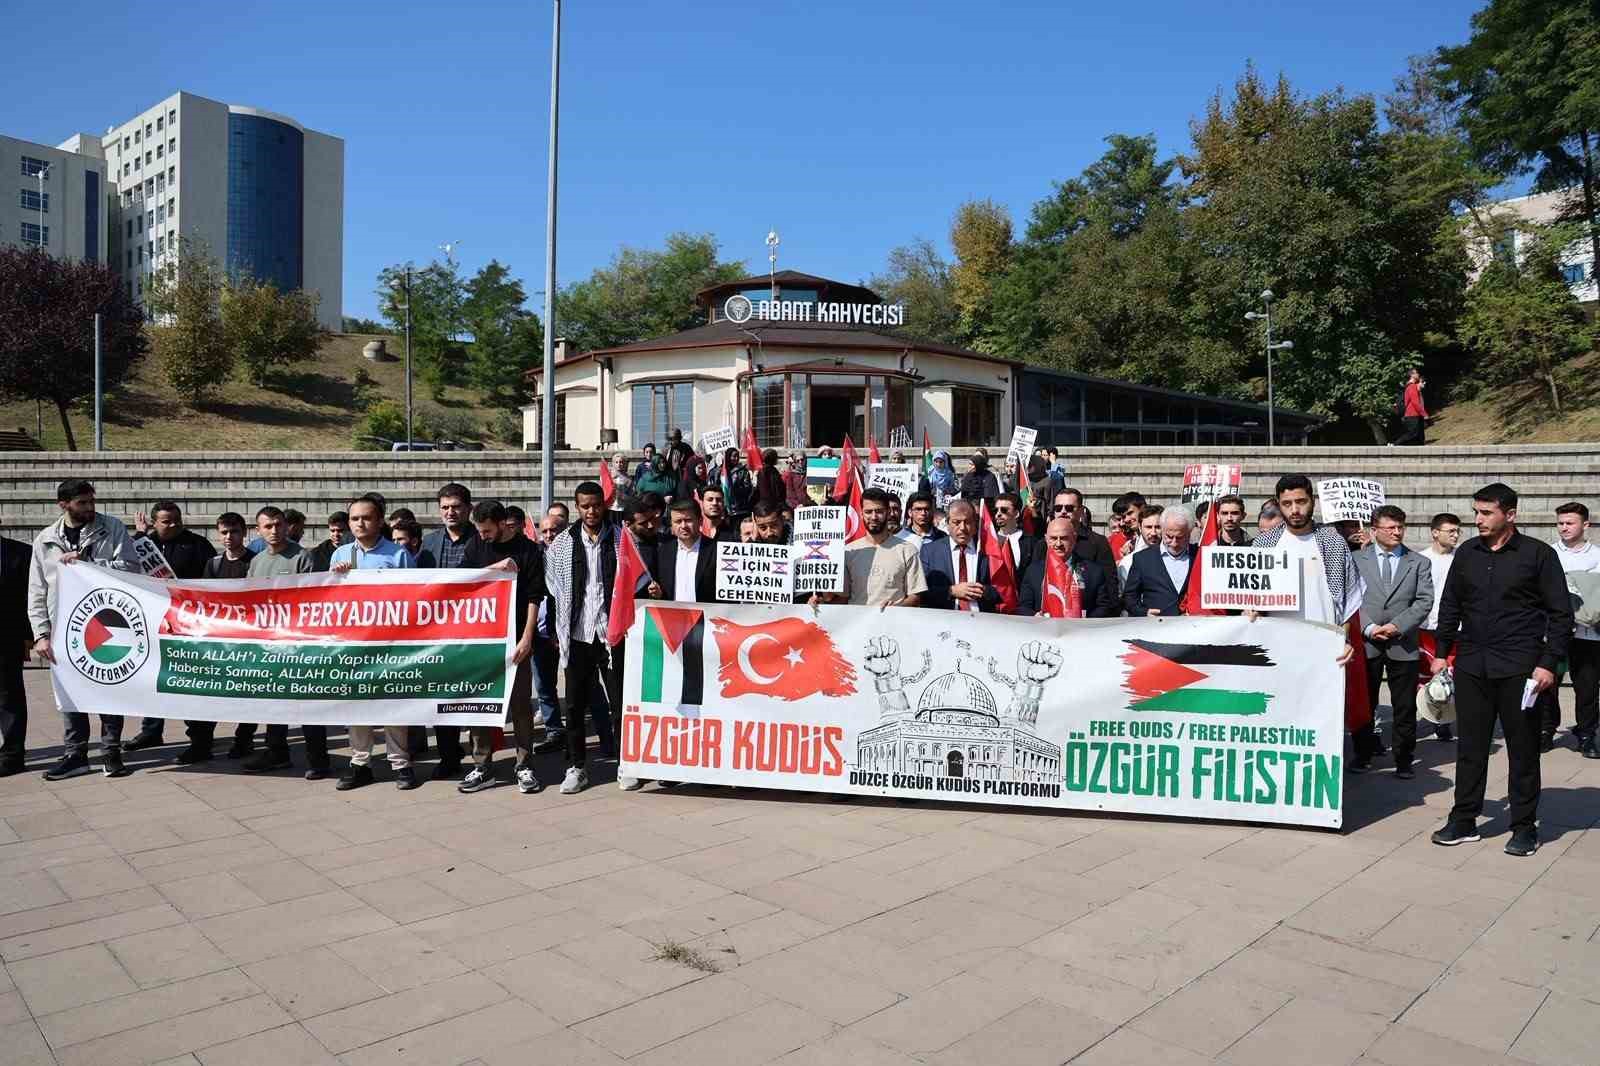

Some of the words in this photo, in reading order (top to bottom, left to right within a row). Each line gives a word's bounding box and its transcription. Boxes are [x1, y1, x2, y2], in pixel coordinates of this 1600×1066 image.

[759, 300, 813, 321] ABANT
[710, 440, 731, 450] VAR!
[798, 508, 840, 520] TERÖRİST
[811, 521, 822, 530] VE
[722, 544, 788, 558] ZALİMLER
[742, 559, 771, 573] İÇİN
[795, 562, 839, 576] SÜRESİZ
[727, 575, 783, 588] YAŞASIN
[795, 578, 837, 590] BOYKOT
[1227, 573, 1271, 590] AKSA
[718, 589, 791, 603] CEHENNEM
[1204, 593, 1297, 606] ONURUMUZDUR!
[117, 598, 145, 637] DESTEK
[297, 600, 409, 627] FERYADINI
[416, 597, 497, 625] DUYUN
[166, 647, 199, 660] Sakın
[260, 651, 332, 665] Zalimlerin
[76, 655, 136, 680] PLATFORMU
[168, 661, 221, 675] Habersiz
[278, 668, 324, 680] ALLAH
[329, 668, 374, 680] Onları
[378, 668, 423, 680] Ancak
[166, 676, 222, 690] Gözlerin
[225, 678, 286, 694] Dehşetle
[290, 683, 352, 696] Bakacağı
[358, 683, 379, 694] Bir
[384, 682, 422, 694] Güne
[428, 681, 494, 696] Erteliyor
[622, 705, 723, 769] ÖZGÜR
[732, 720, 843, 777] KUDÜS
[1090, 720, 1125, 737] FREE
[1129, 721, 1173, 739] QUDS
[1189, 724, 1226, 742] FREE
[1230, 724, 1316, 747] PALESTİNE
[1066, 732, 1180, 799] ÖZGÜR
[1191, 746, 1341, 810] FİLİSTİN
[850, 771, 889, 787] DÜZCE
[891, 772, 933, 791] ÖZGÜR
[936, 776, 980, 794] KUDÜS
[983, 780, 1060, 798] PLATFORMU
